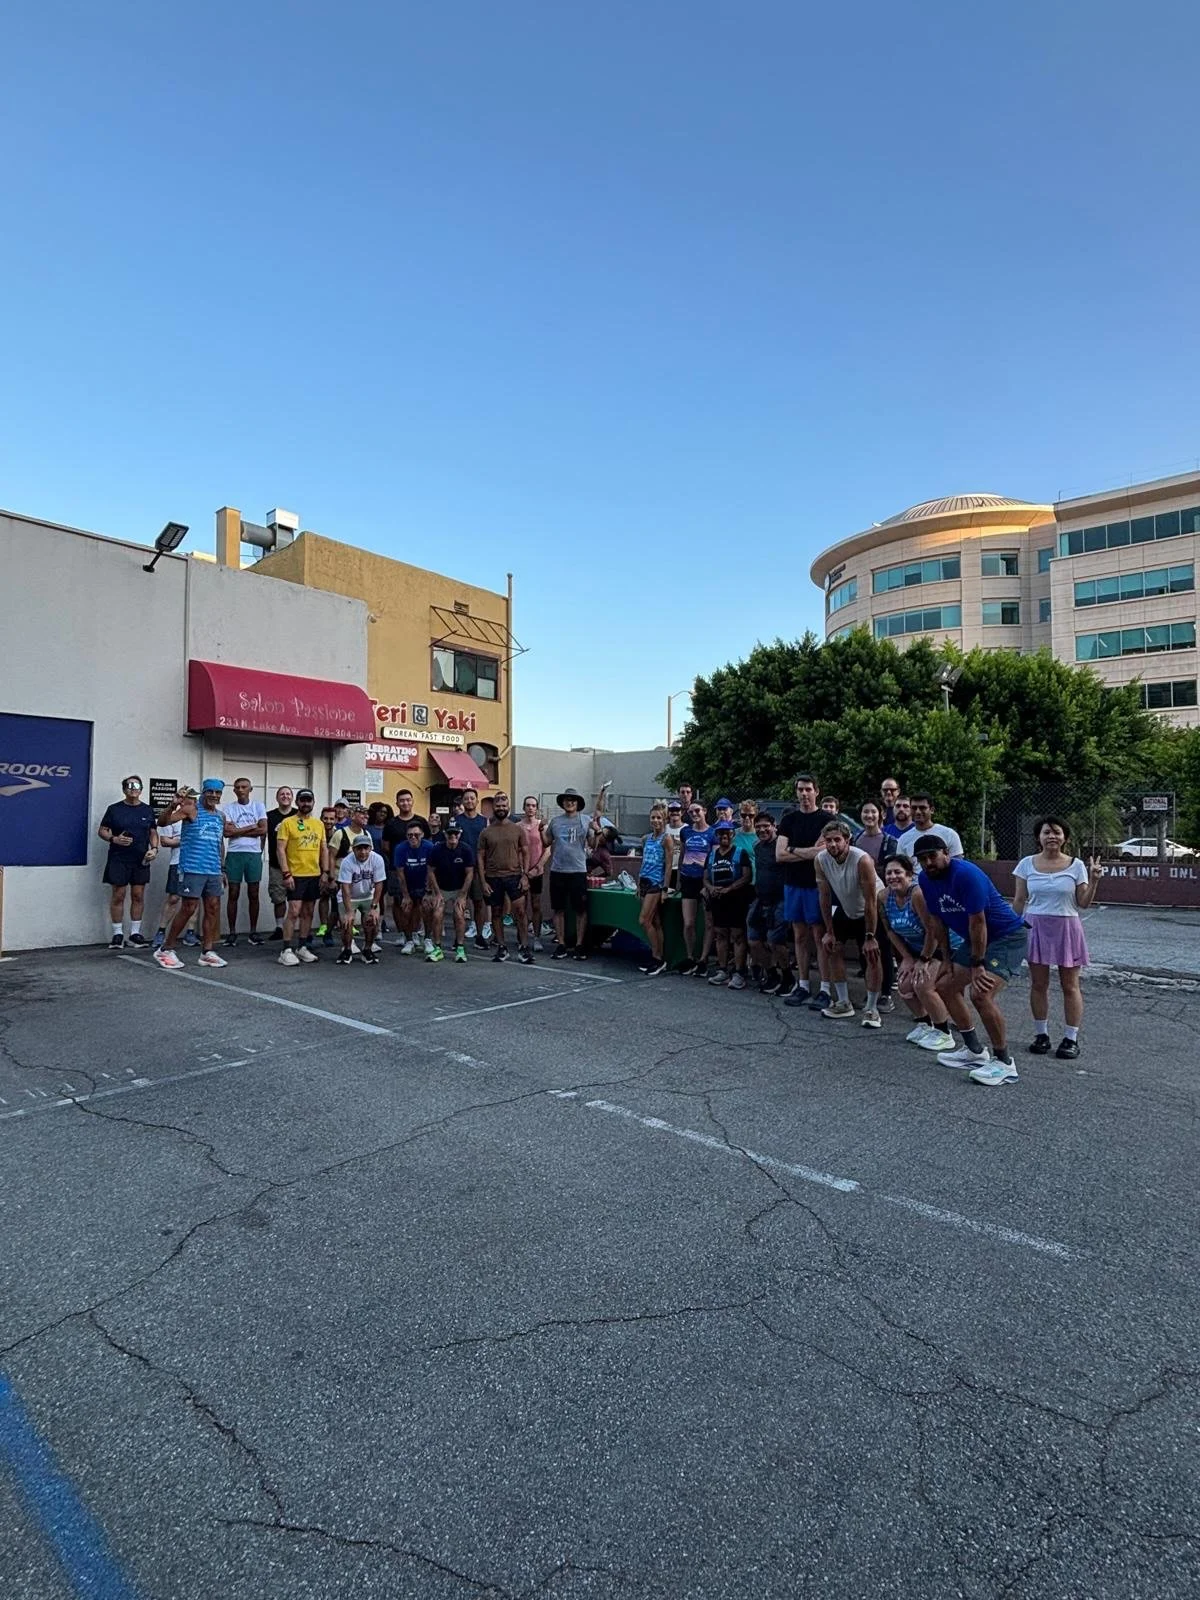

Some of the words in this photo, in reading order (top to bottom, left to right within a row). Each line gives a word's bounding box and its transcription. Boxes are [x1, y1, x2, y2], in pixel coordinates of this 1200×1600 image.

[238, 691, 285, 713] Salon
[291, 697, 356, 721] Passione
[219, 716, 239, 727] 233
[415, 707, 426, 723] &
[434, 709, 476, 731] Yaki
[389, 729, 418, 738] KOREAN
[421, 732, 437, 741] FAST
[441, 735, 460, 743] FOOD
[365, 751, 378, 761] 30
[378, 752, 410, 764] YEARS
[1101, 866, 1160, 878] PARING
